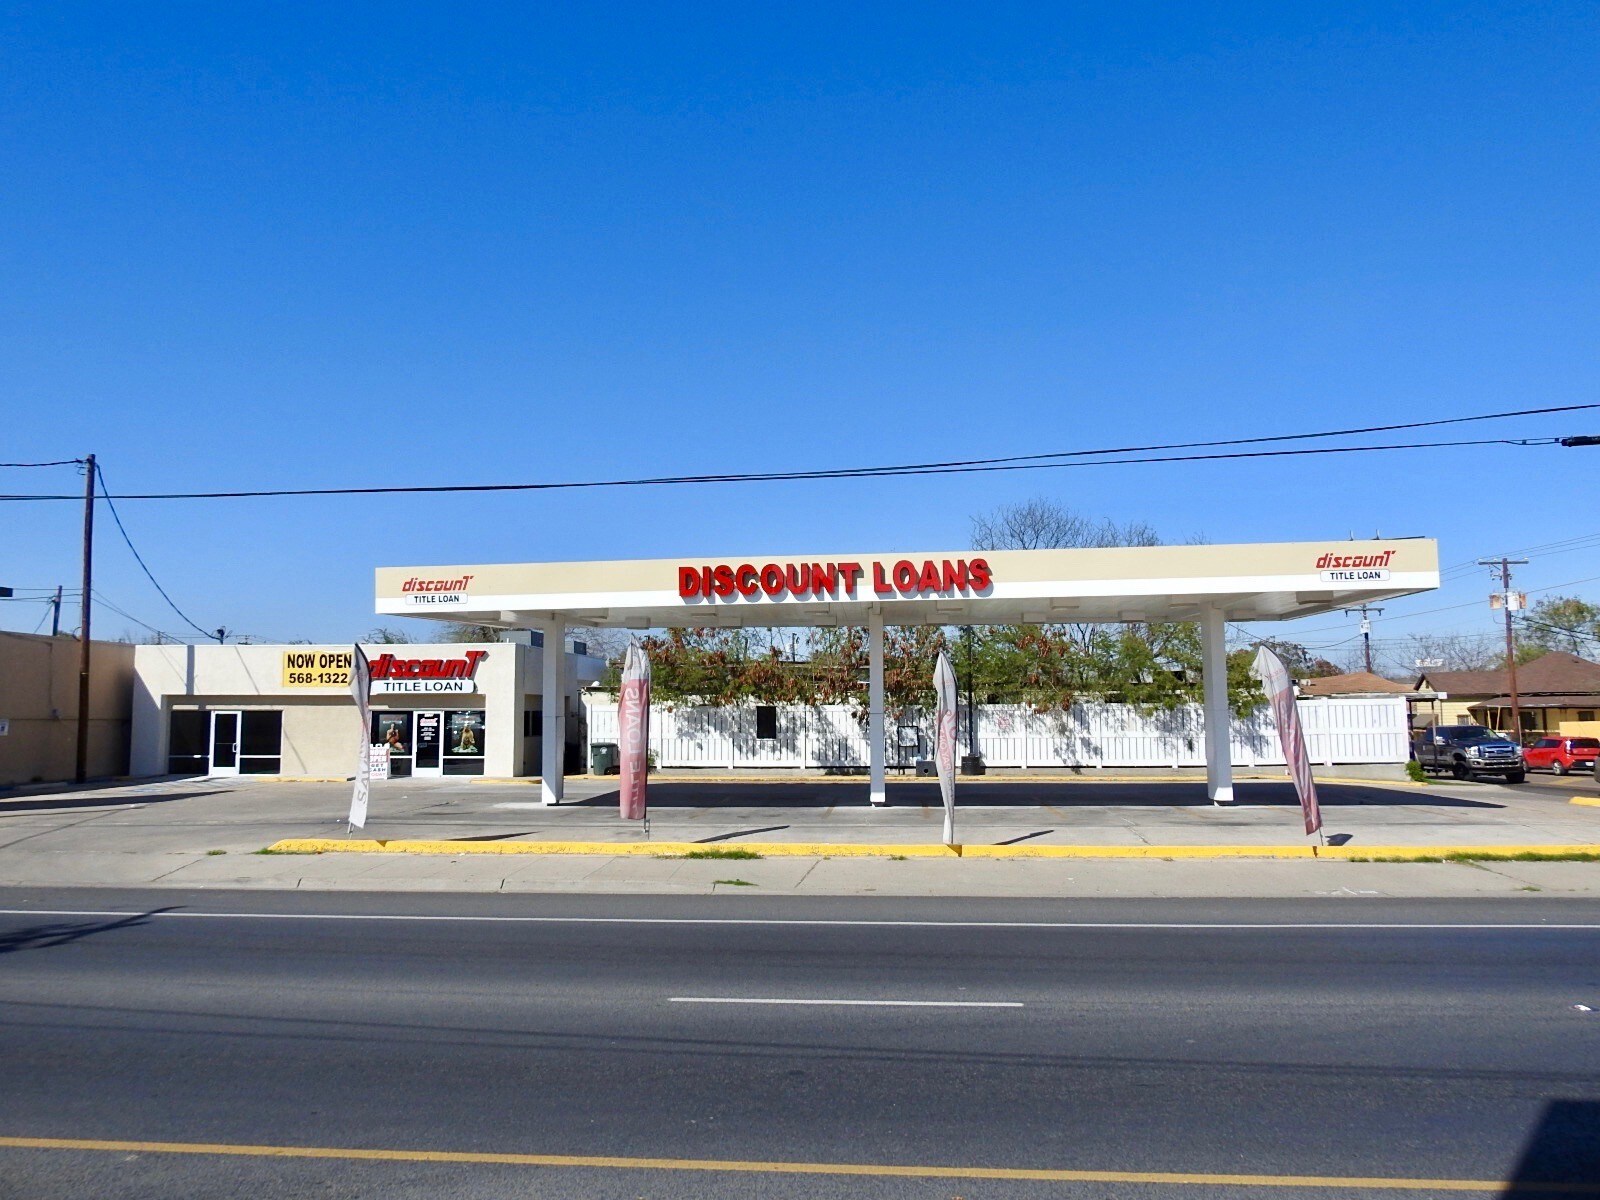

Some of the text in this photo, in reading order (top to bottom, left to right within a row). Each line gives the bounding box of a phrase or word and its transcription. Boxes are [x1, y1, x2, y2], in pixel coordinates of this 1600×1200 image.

[678, 558, 993, 597] DISCOUNT LOANS
[1330, 571, 1381, 580] TITLE LOAN
[414, 595, 460, 603] TITLE LOAN
[287, 654, 351, 669] NOW OPEN
[289, 673, 348, 684] 568-1322
[384, 682, 463, 692] TITLE LOAN
